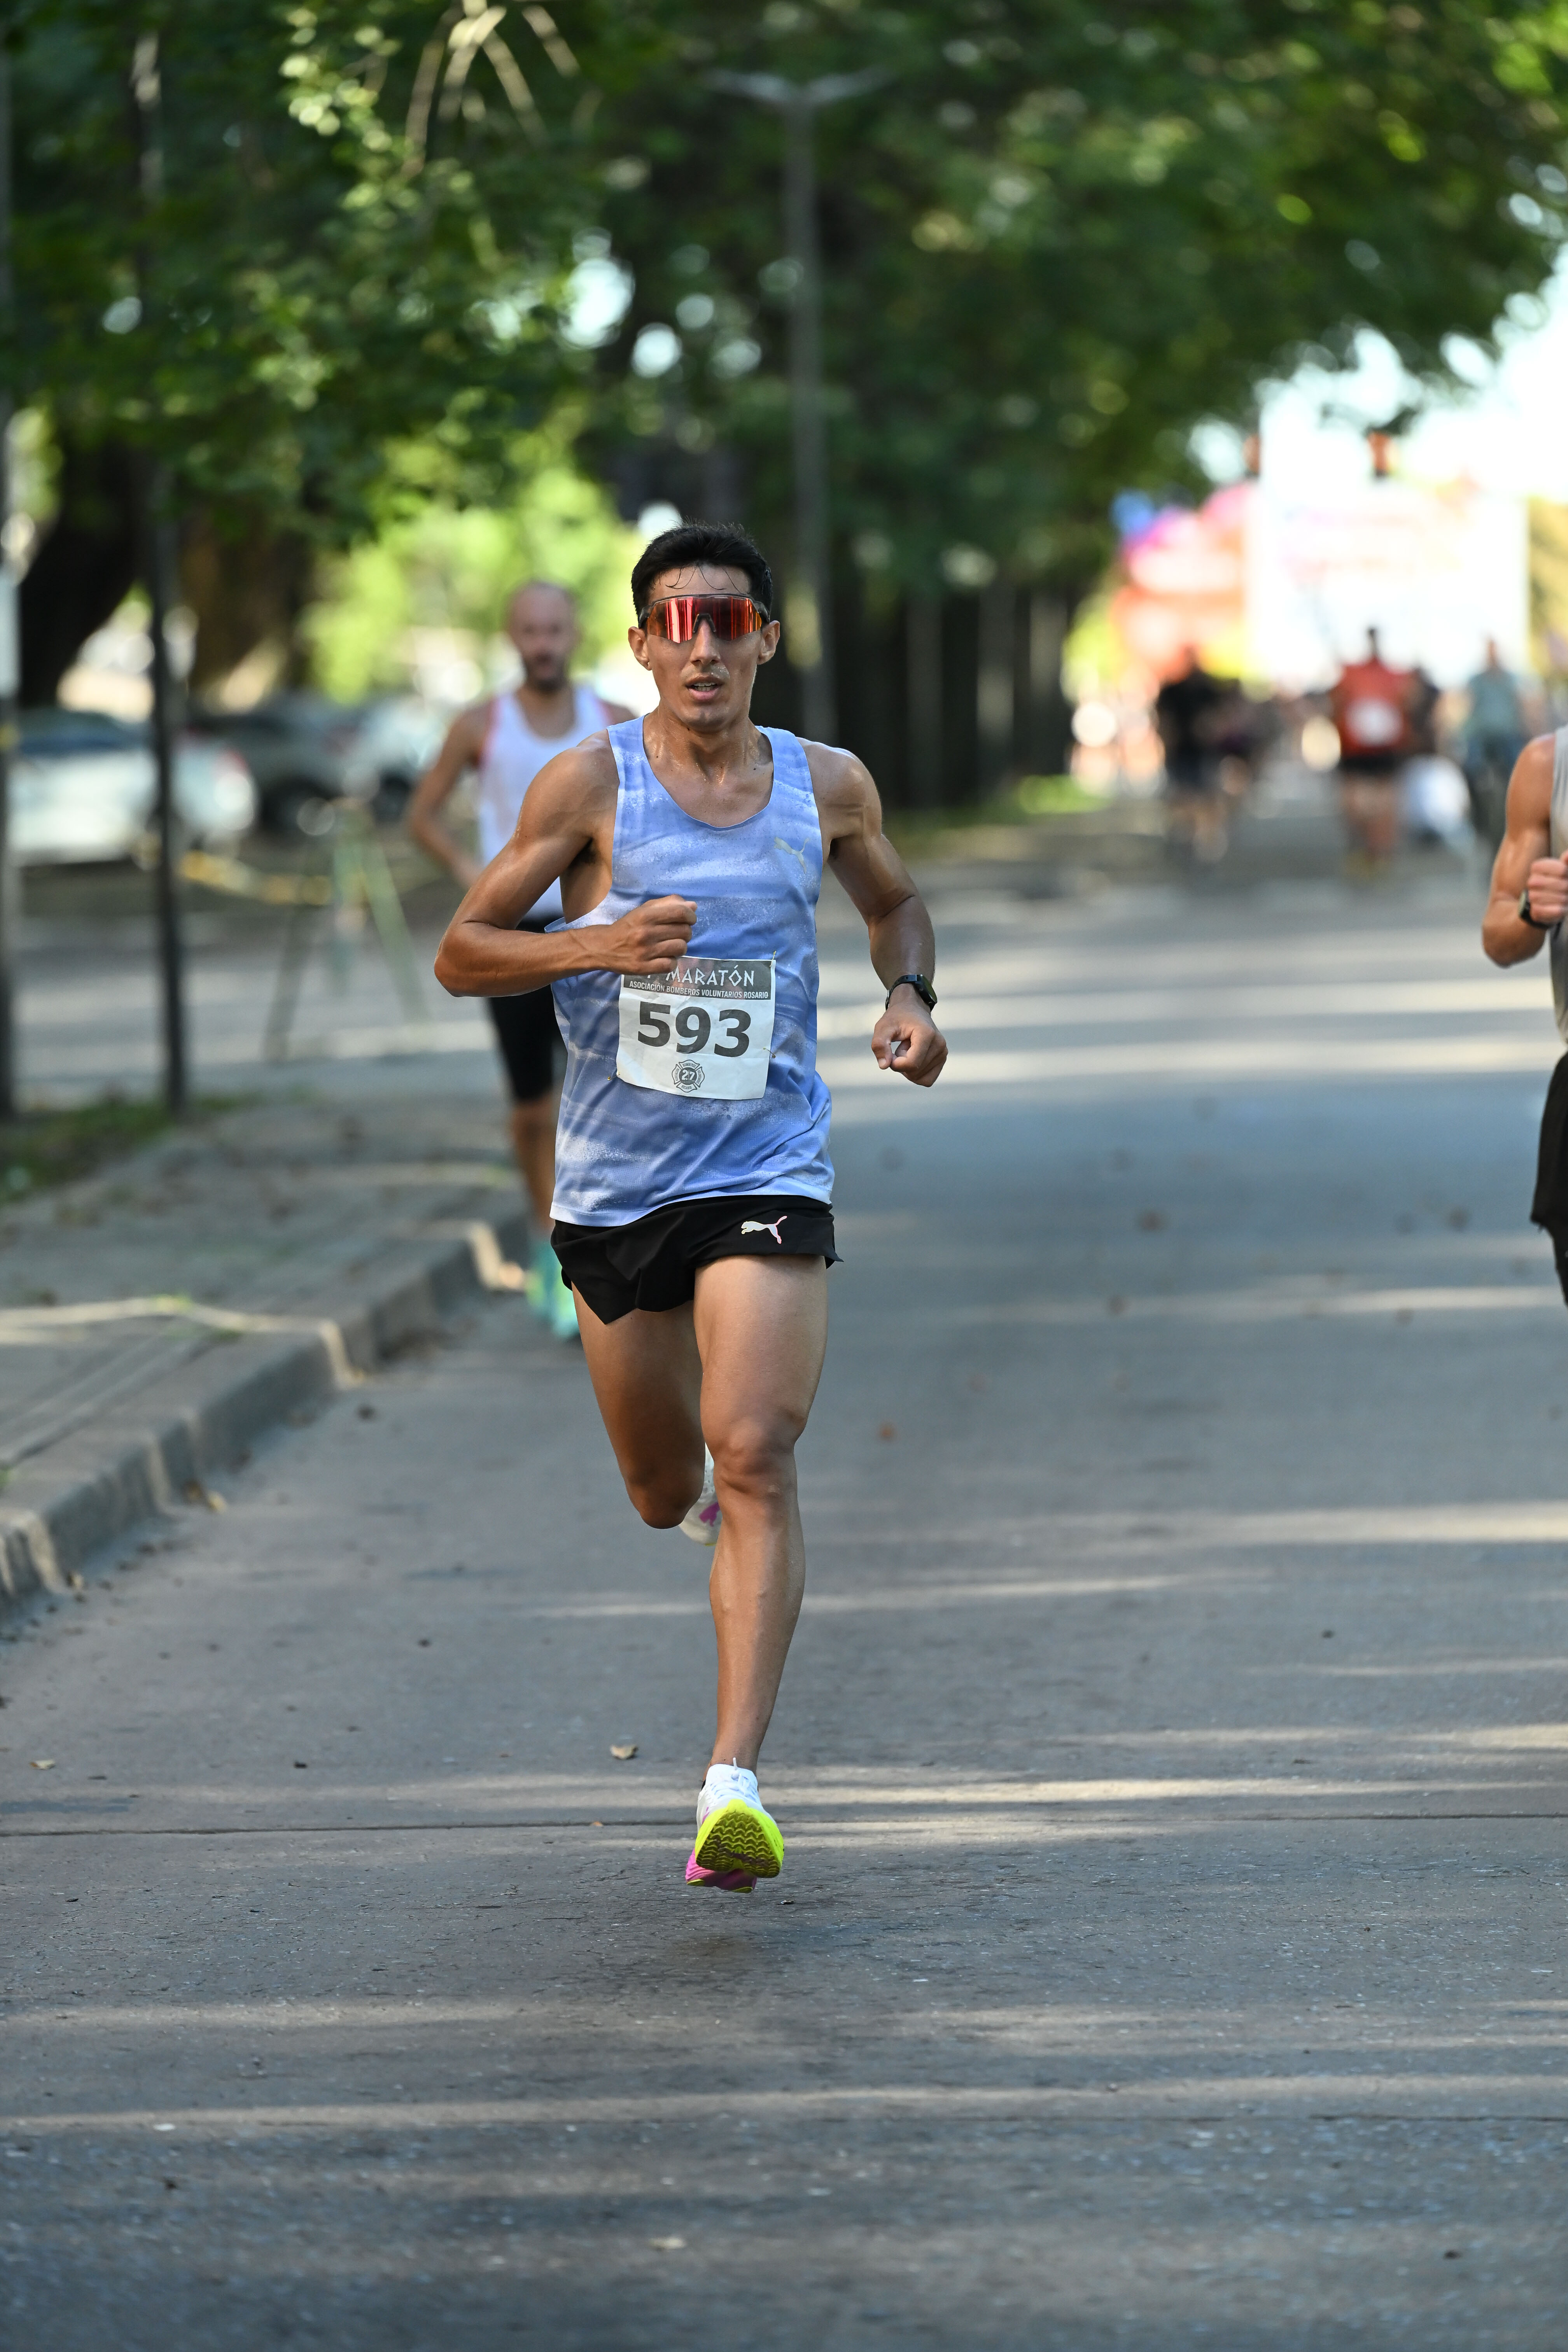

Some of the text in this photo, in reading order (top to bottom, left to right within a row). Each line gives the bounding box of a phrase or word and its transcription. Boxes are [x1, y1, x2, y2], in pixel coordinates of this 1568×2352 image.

[665, 964, 754, 987] MARATÓN
[629, 980, 665, 992] ASOCIACIÓN
[666, 986, 700, 996] BOMBEROS
[702, 989, 742, 998] VOLUNTARIOS
[637, 1001, 751, 1057] 593
[681, 1069, 695, 1080] 27
